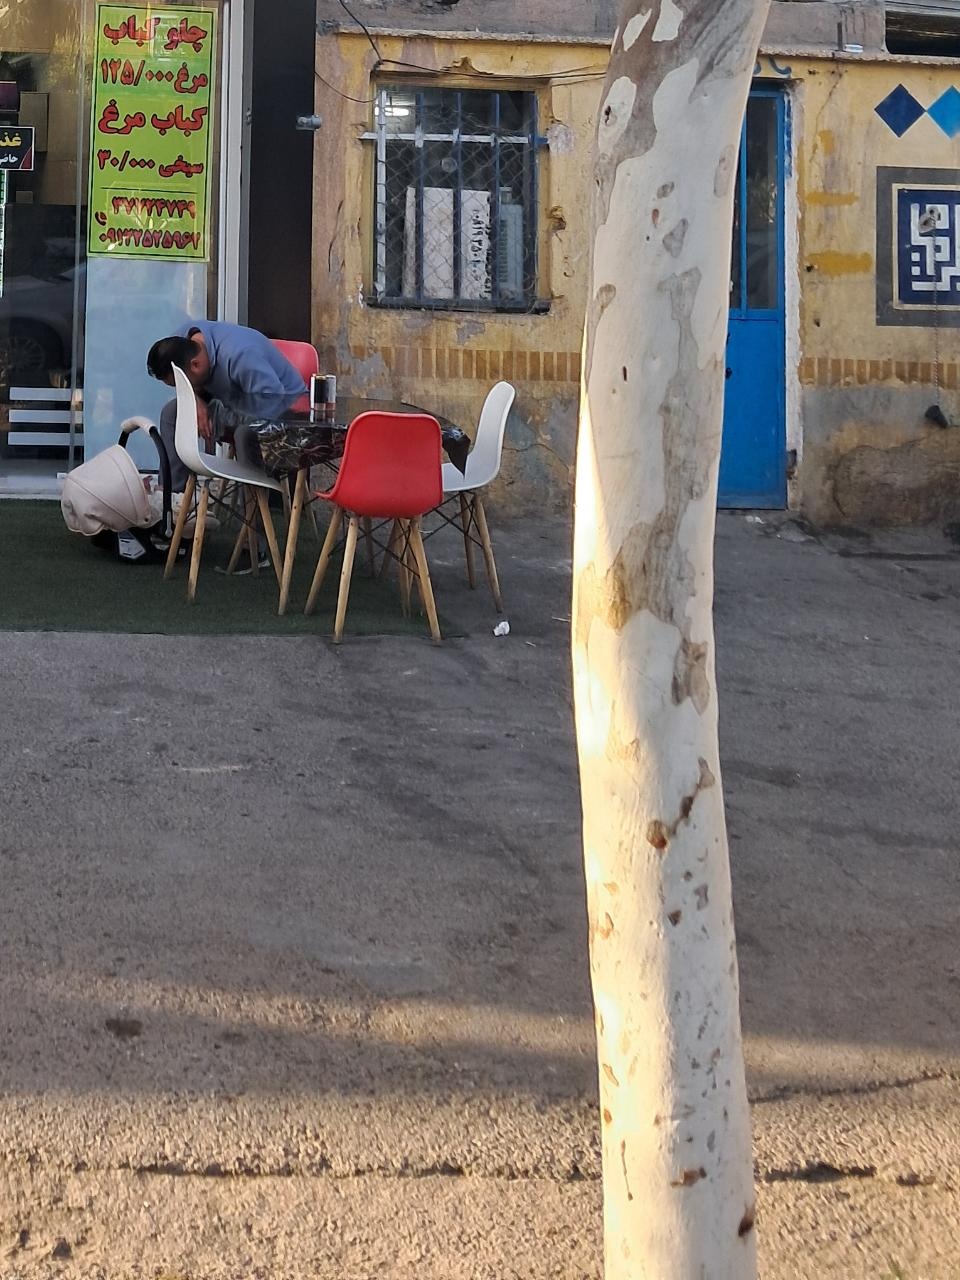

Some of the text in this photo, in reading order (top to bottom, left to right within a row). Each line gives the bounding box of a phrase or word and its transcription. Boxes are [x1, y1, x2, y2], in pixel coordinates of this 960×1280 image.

[103, 14, 208, 53] چلو کباب
[101, 57, 208, 94] مرغ ۱۲۵/۰۰۰
[98, 98, 208, 138] کباب مرغ
[97, 148, 156, 172] ۳۰/۰۰۰
